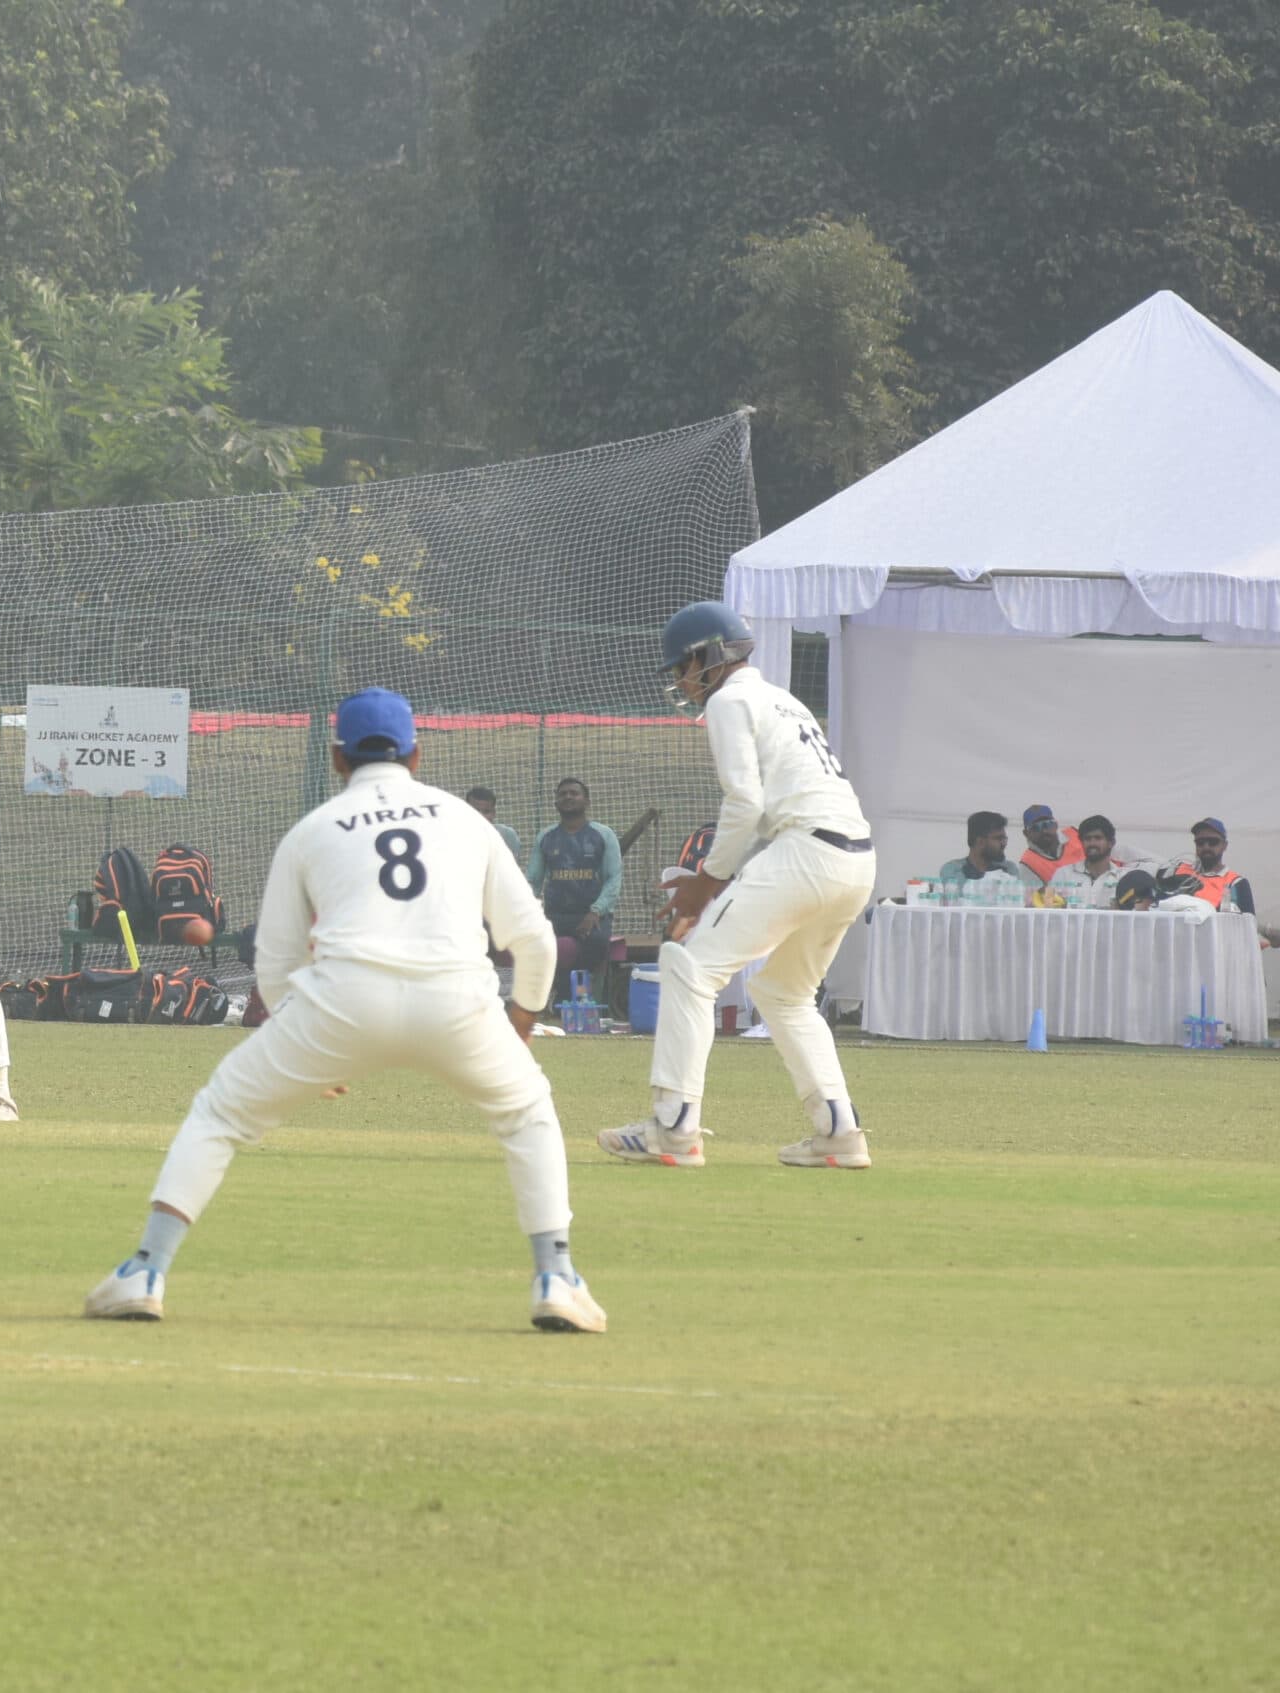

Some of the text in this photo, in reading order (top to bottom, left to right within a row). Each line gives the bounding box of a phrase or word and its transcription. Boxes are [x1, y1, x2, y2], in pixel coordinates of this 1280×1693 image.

[37, 731, 180, 743] JJ IRANI CRICKET ACADEMY
[75, 748, 136, 767] ZONE
[154, 750, 167, 767] 3
[335, 804, 441, 832] VIRAT
[374, 827, 427, 902] 8
